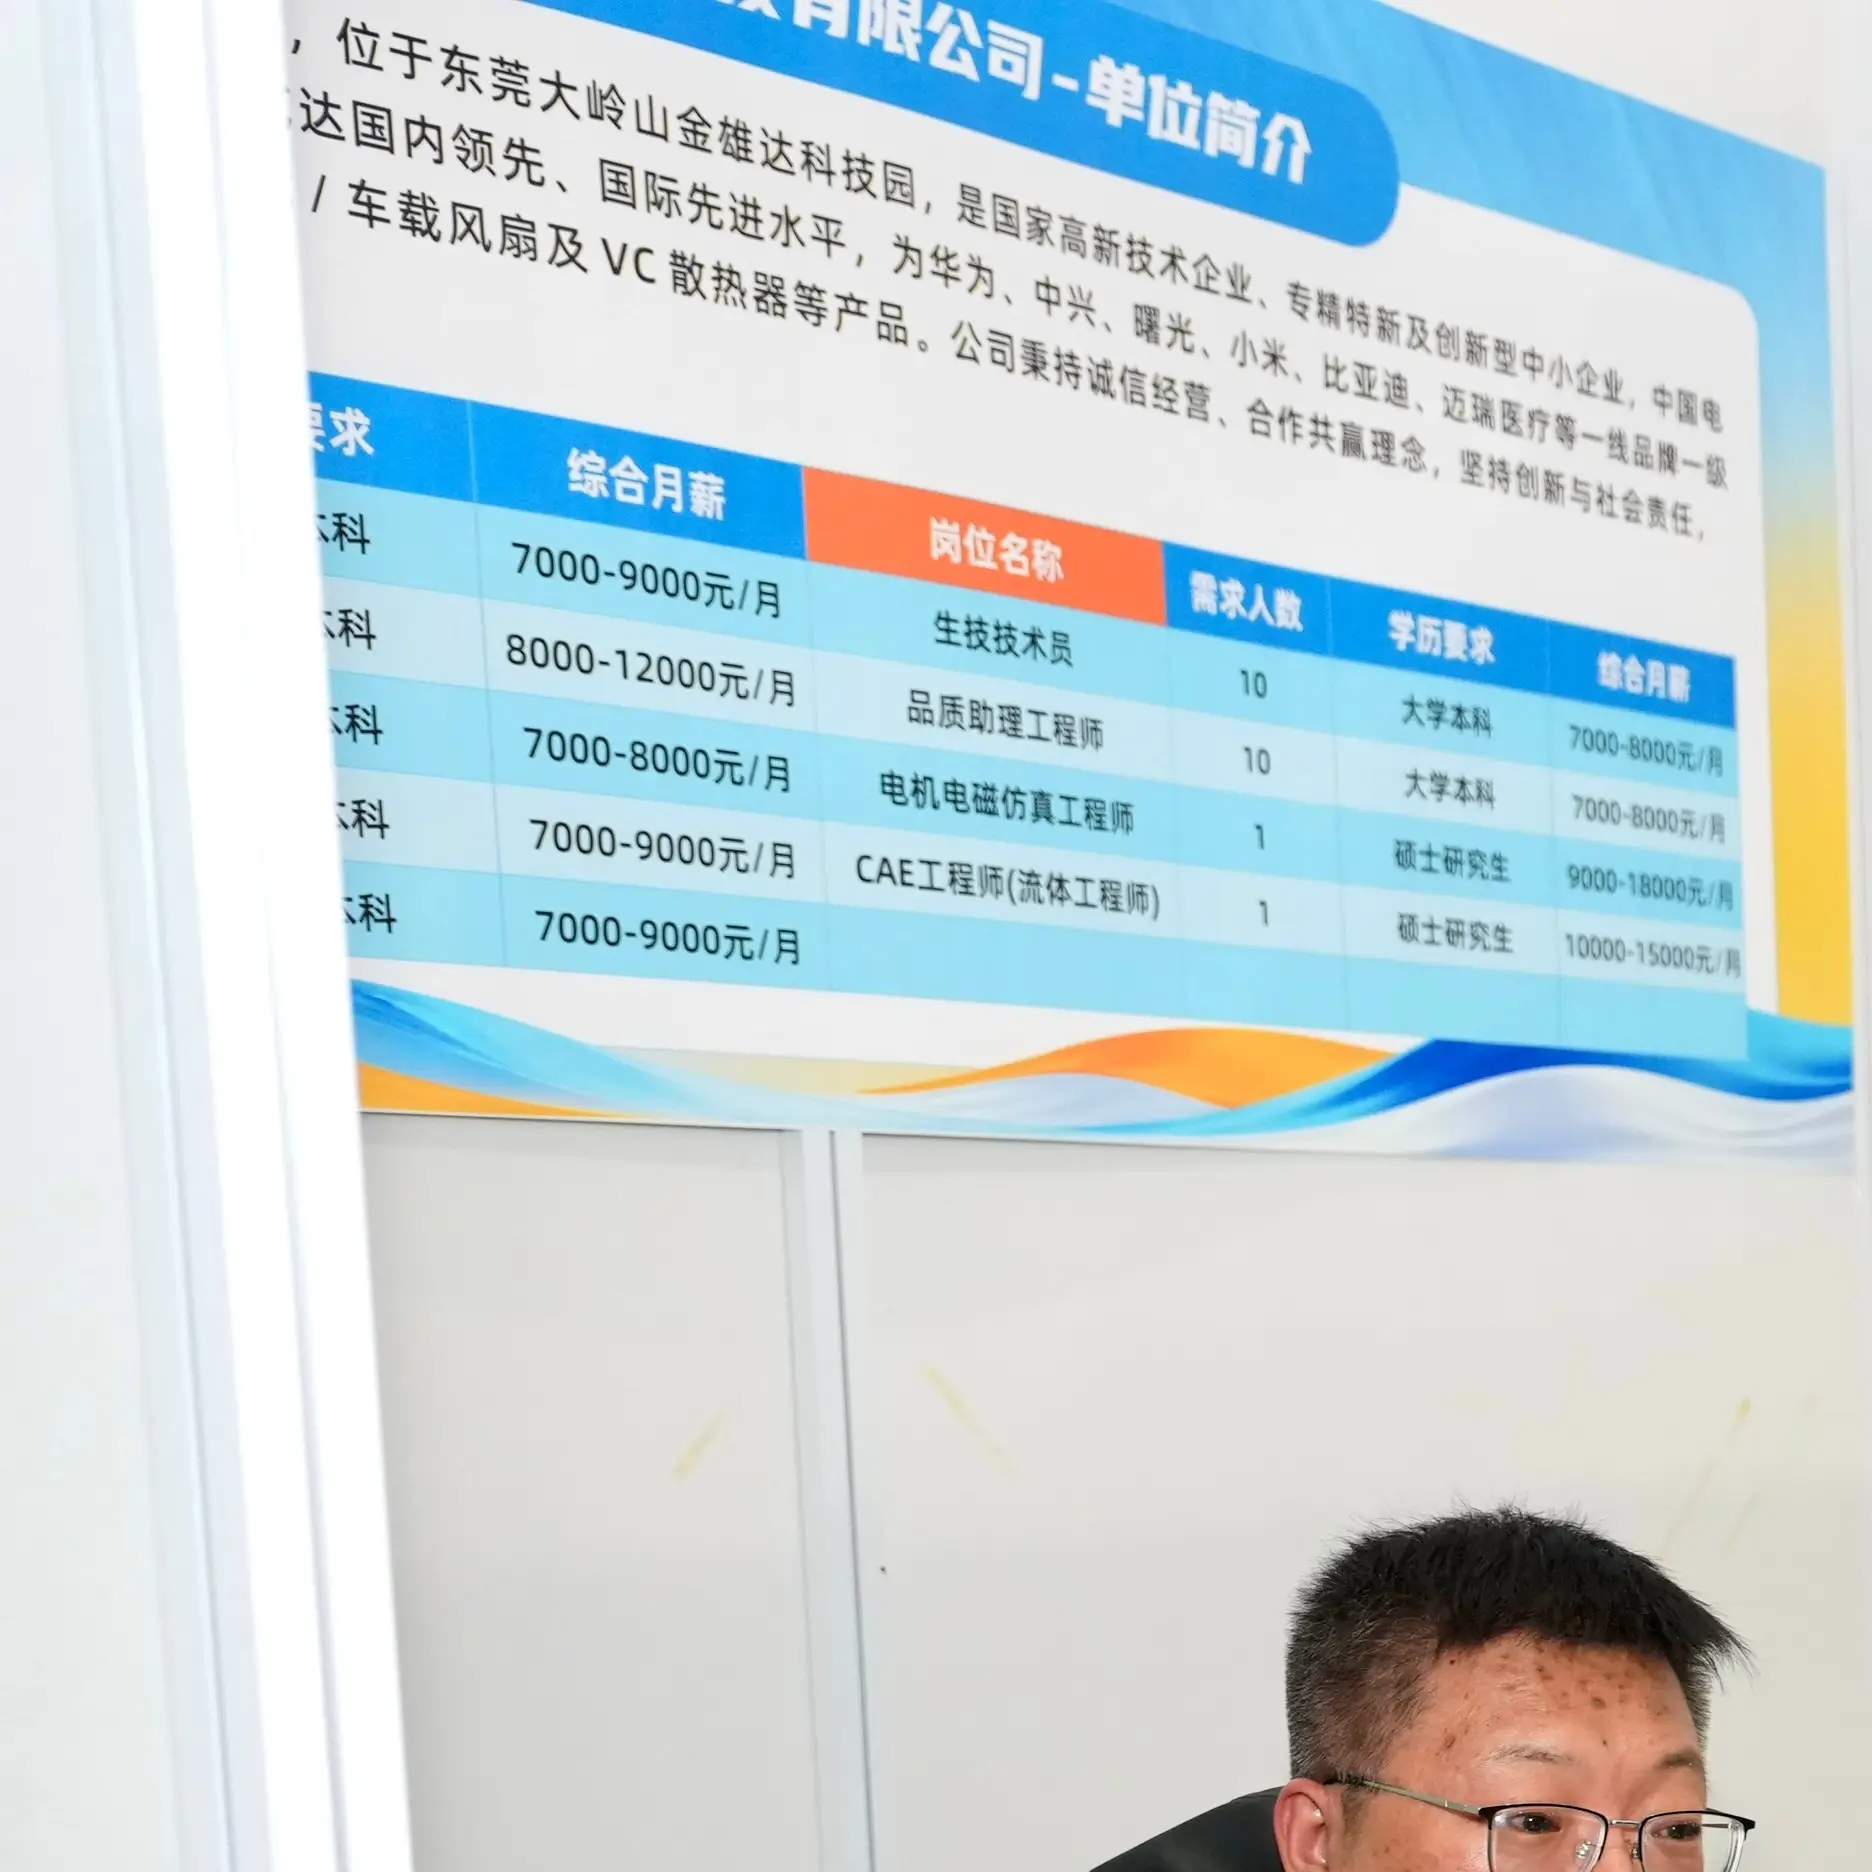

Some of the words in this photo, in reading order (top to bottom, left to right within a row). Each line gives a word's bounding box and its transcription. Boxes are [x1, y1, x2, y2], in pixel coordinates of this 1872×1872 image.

[716, 0, 1312, 184] 有限公司-单位简介
[347, 178, 590, 275] 车载风扇及
[602, 241, 657, 288] VC
[511, 542, 781, 620] 7000-9000元/月
[934, 609, 1074, 668] 生技技术员
[1239, 669, 1267, 699] 10
[1402, 694, 1493, 738] 大学本科
[1568, 725, 1724, 778] 7000-8000元/月
[567, 446, 727, 521] 综合月薪
[929, 518, 1065, 584] 岗位名称
[1189, 571, 1304, 631] 需求人数
[1388, 610, 1495, 665] 学历要求
[1597, 652, 1691, 703] 综合月薪
[506, 633, 795, 707] 8000-12000元/月
[907, 689, 1104, 753] 品质助理工程师
[1243, 747, 1271, 776] 10
[1405, 768, 1496, 811] 大学本科
[1572, 795, 1726, 844] 7000-8000元/月
[523, 727, 791, 794] 7000-8000元/月
[879, 770, 1135, 835] 电机电磁仿真工程师
[1255, 824, 1266, 850] 1
[1393, 839, 1512, 884] 硕士研究生
[1567, 864, 1734, 912] 9000-18000元/月
[529, 818, 796, 880] 7000-9000元/月
[856, 853, 1161, 922] CAE工程师(流体工程师)
[1259, 900, 1270, 927] 1
[1396, 912, 1514, 955] 硕士研究生
[1565, 932, 1742, 980] 10000-15000元/月
[535, 910, 799, 966] 7000-9000元/月
